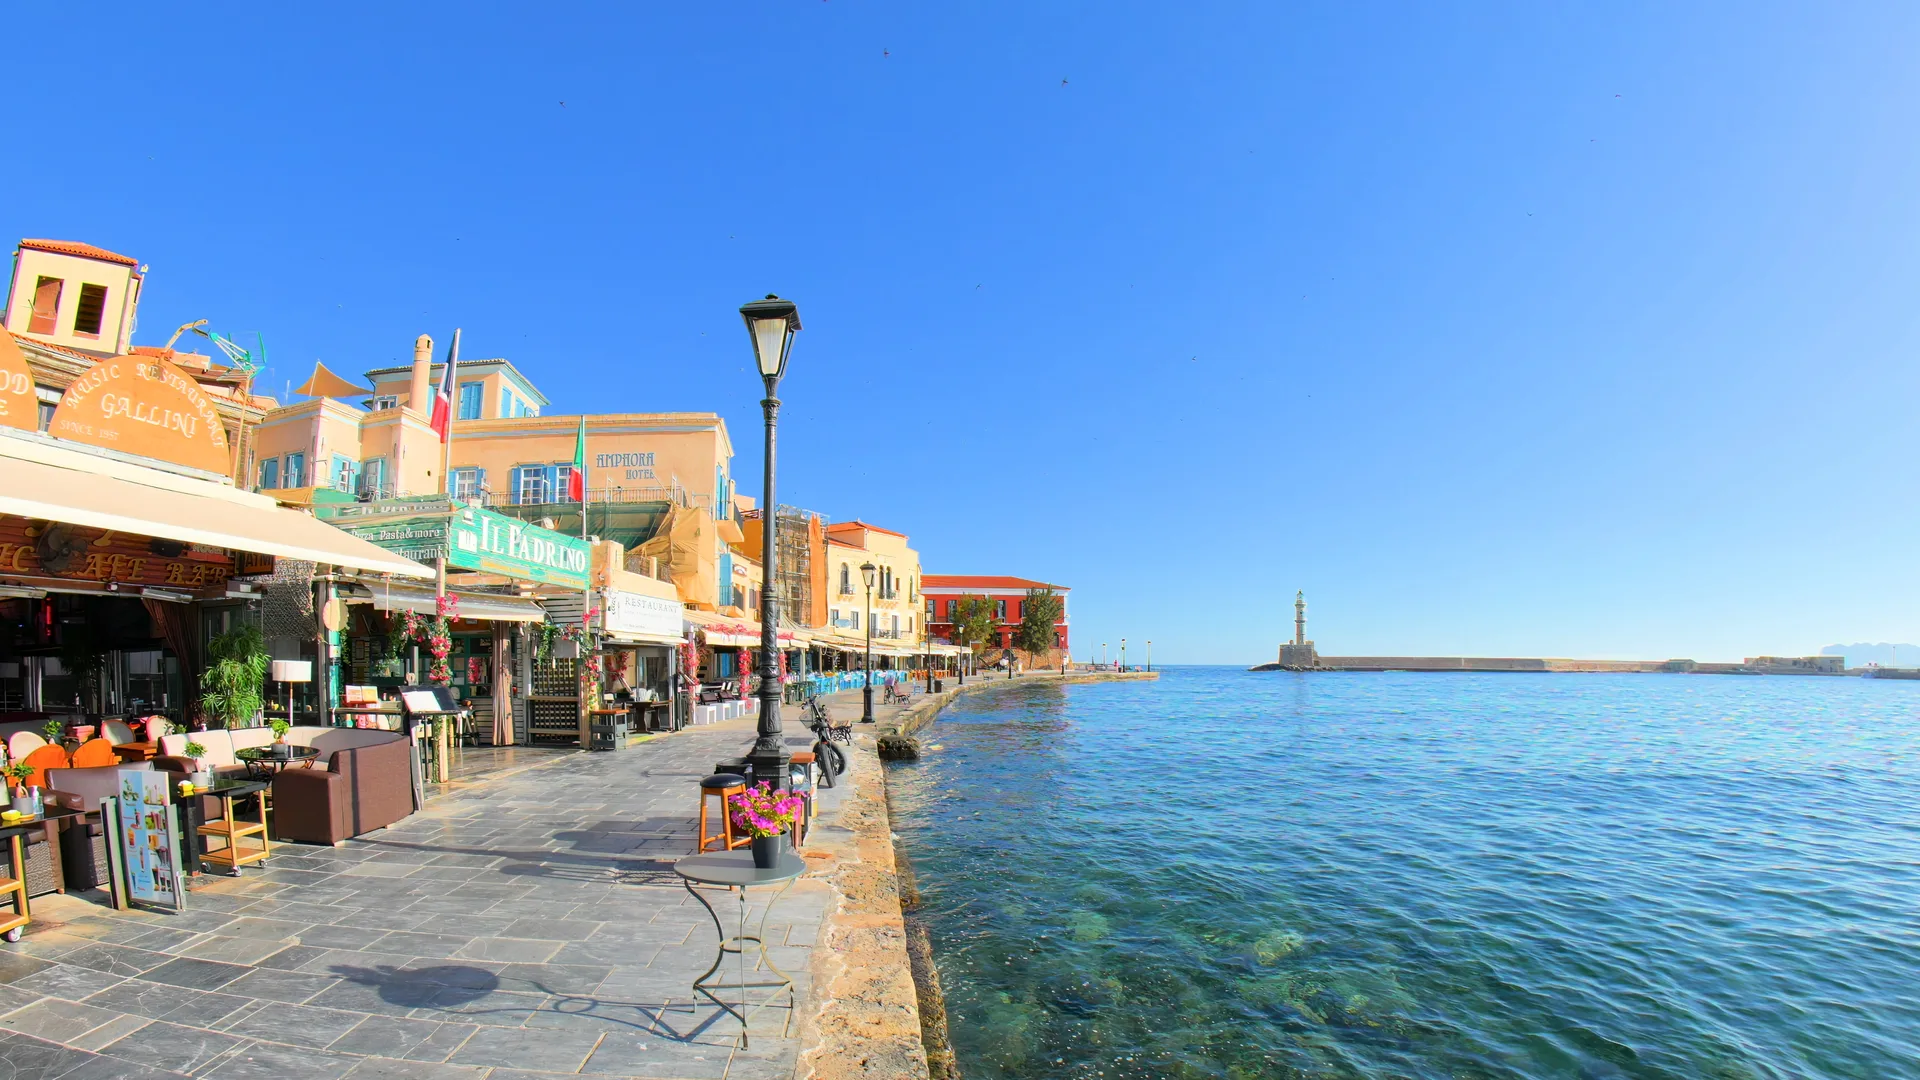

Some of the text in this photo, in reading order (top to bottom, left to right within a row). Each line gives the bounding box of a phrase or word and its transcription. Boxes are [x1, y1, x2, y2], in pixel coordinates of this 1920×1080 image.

[66, 363, 225, 449] MUSIC RESTAURANT
[101, 393, 198, 439] GALLINI
[59, 419, 93, 436] SINCE
[596, 452, 655, 468] AMPHORA
[626, 469, 655, 480] HOTEL
[166, 562, 227, 586] BAR
[625, 597, 678, 614] RESTAURANT
